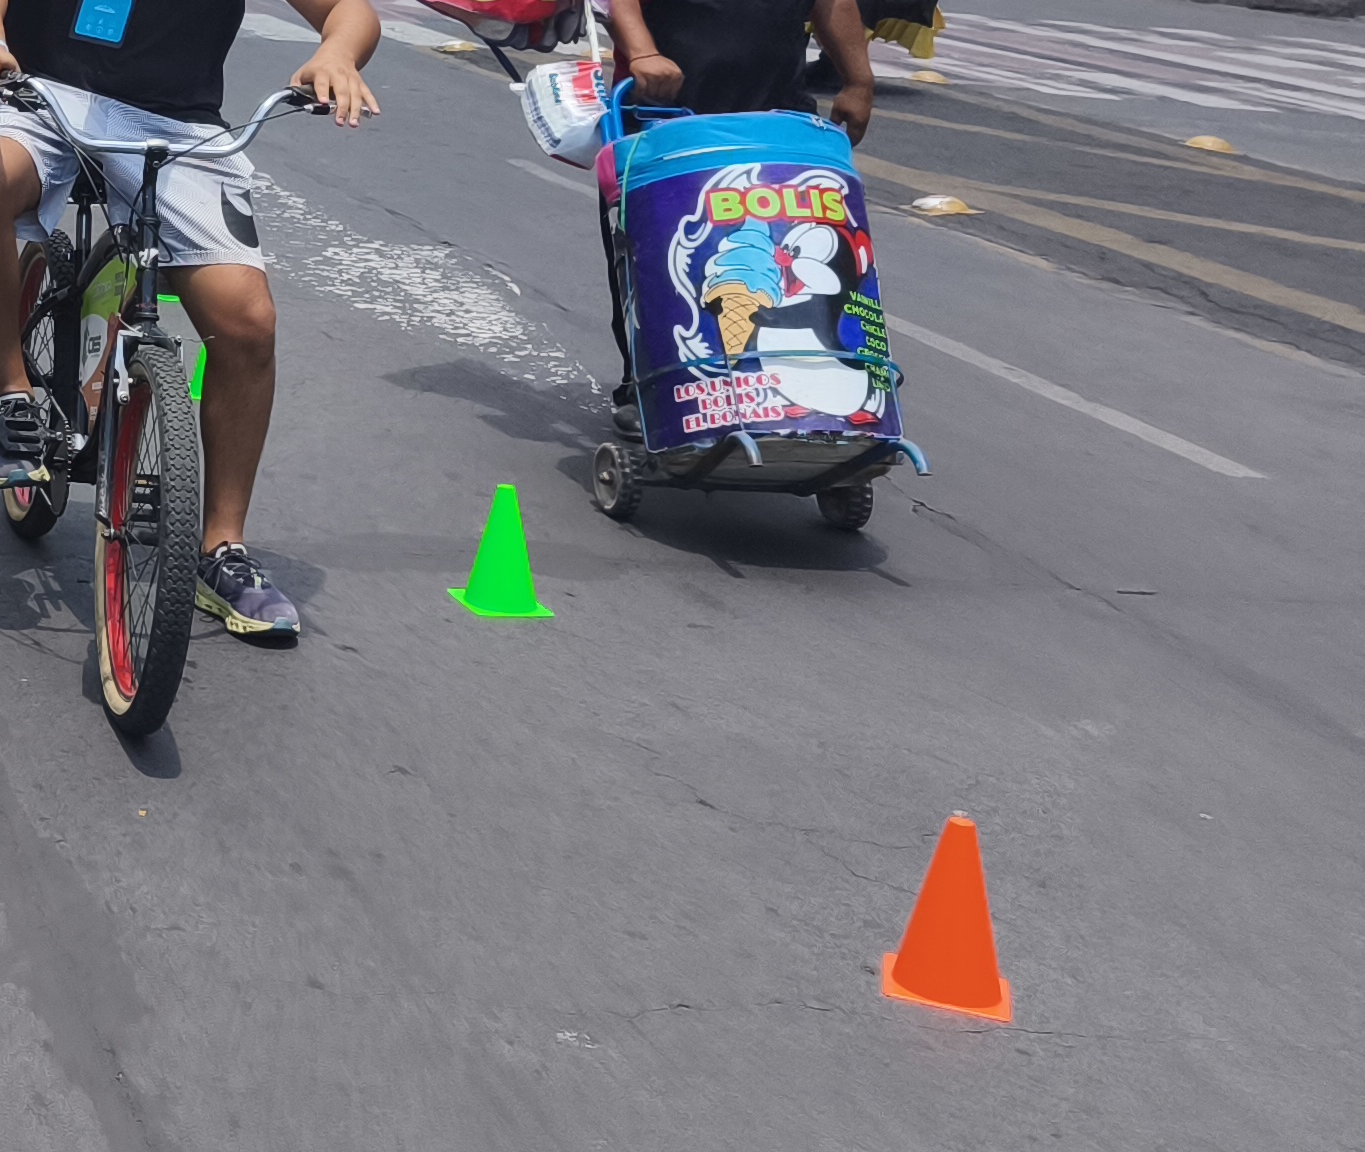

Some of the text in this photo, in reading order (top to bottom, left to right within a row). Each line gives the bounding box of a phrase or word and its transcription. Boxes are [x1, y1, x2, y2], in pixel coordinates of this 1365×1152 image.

[709, 187, 846, 221] BOLIS
[675, 372, 782, 400] LOS UNICOS
[700, 391, 757, 410] BOLIS
[684, 415, 708, 431] EL
